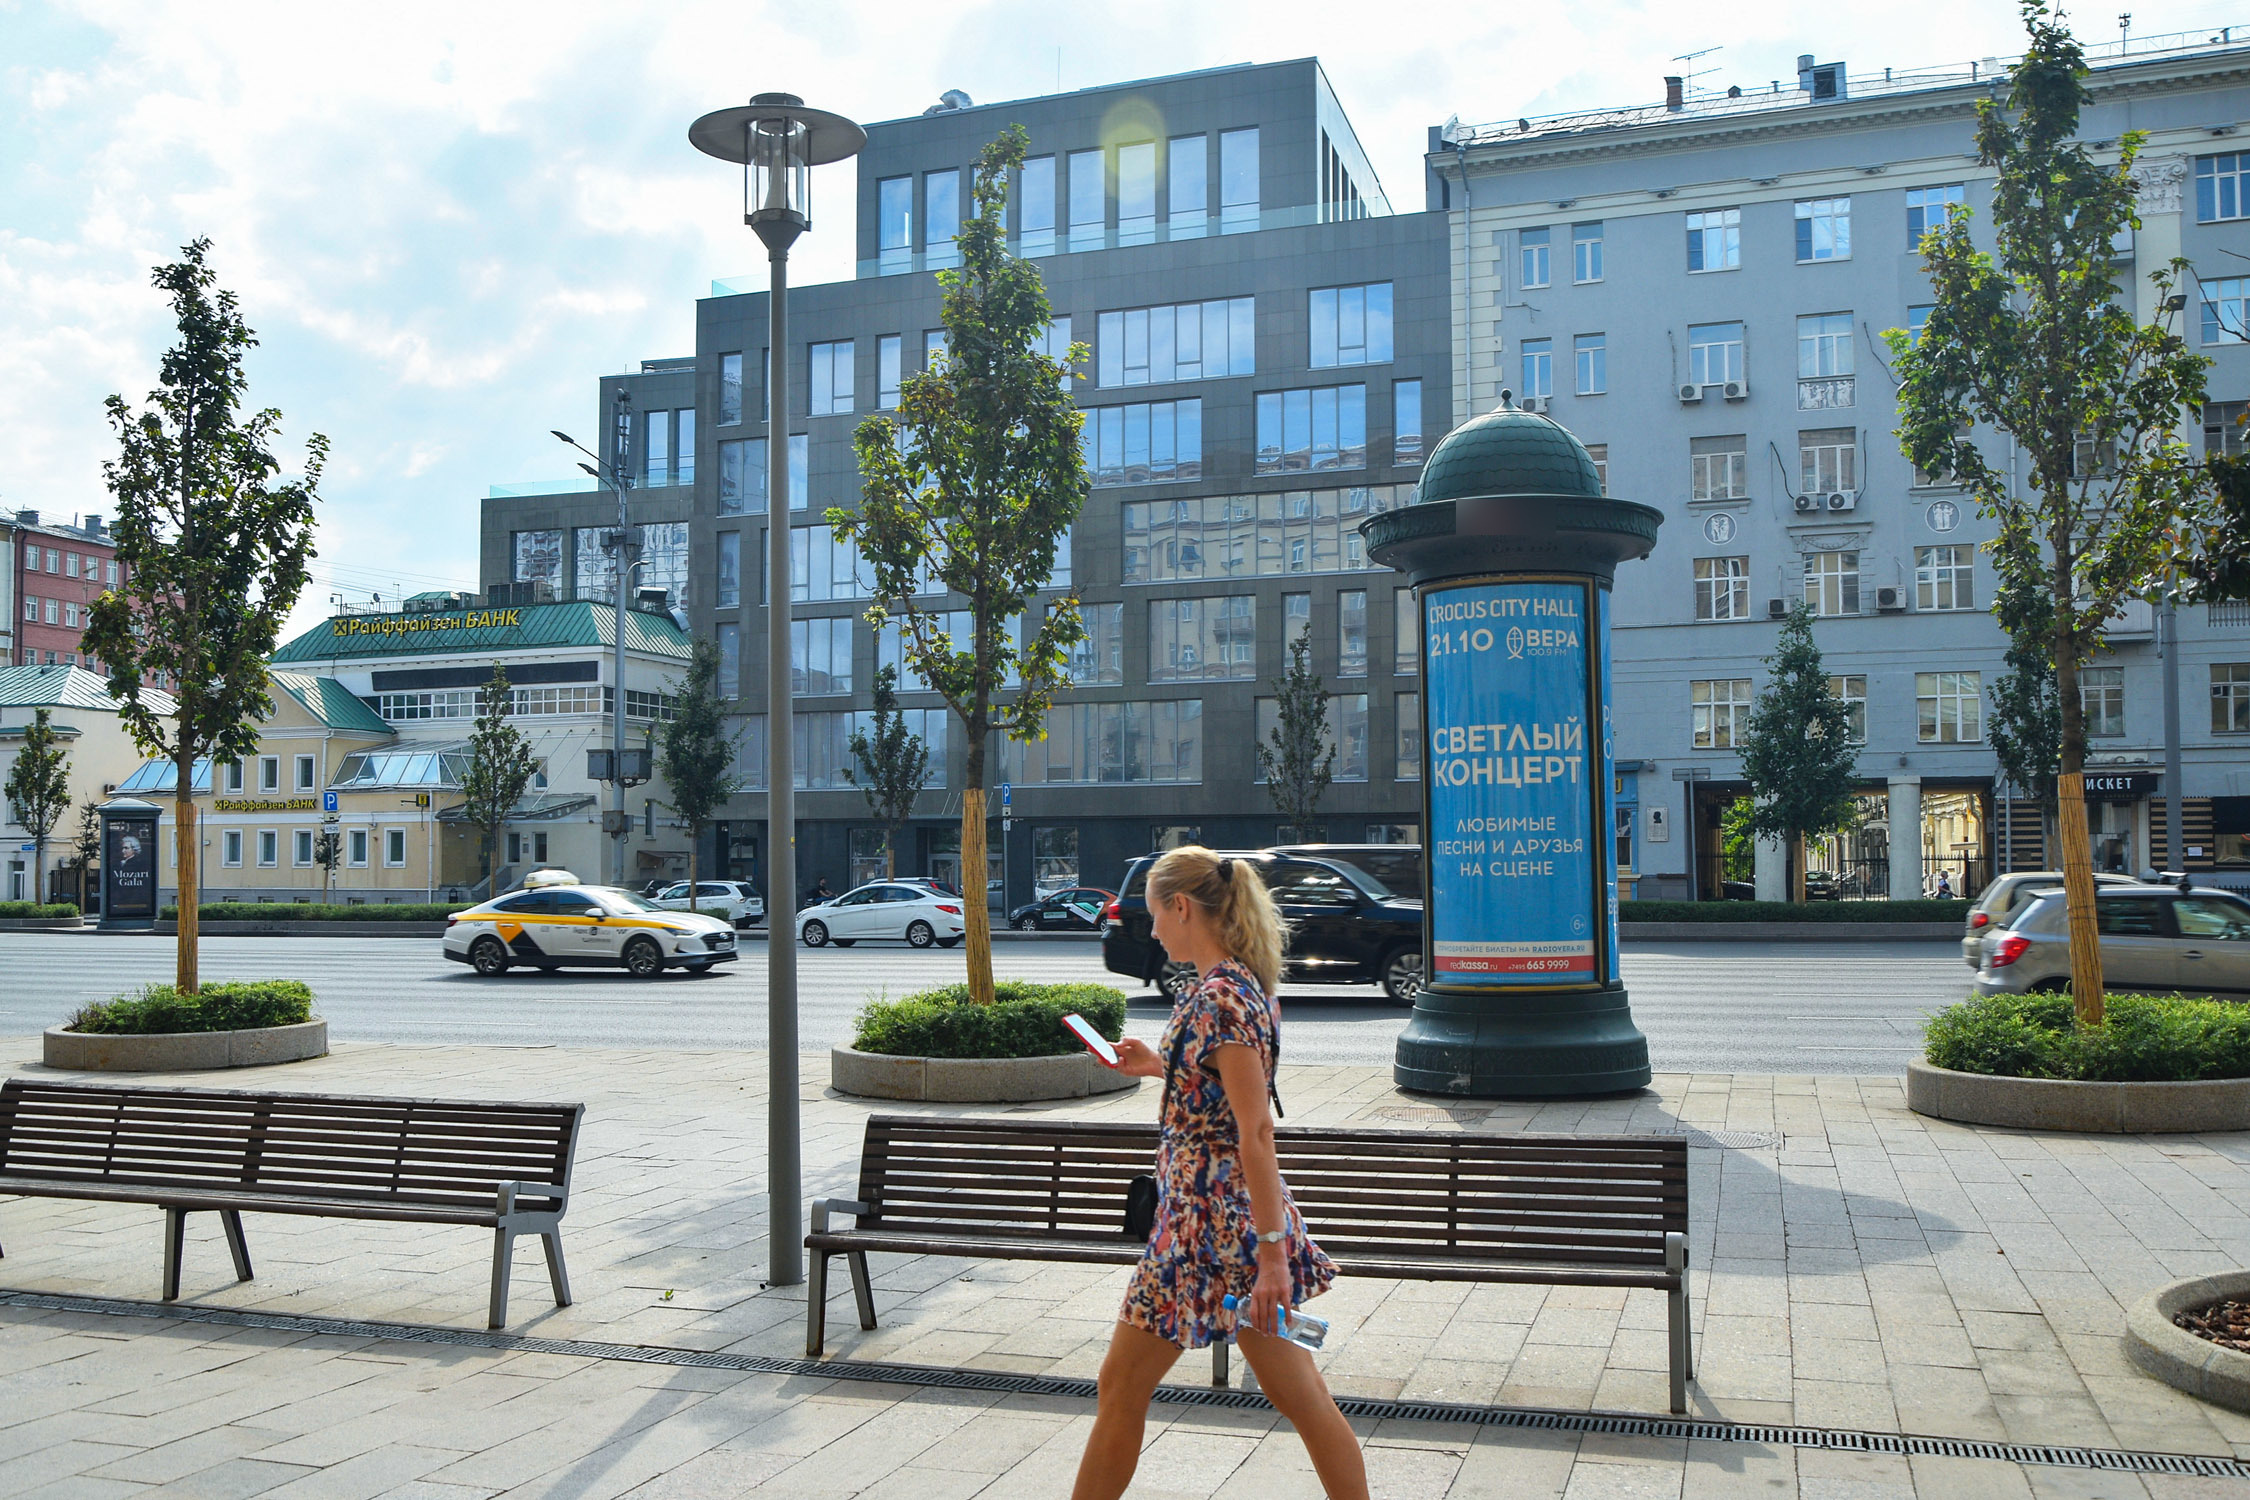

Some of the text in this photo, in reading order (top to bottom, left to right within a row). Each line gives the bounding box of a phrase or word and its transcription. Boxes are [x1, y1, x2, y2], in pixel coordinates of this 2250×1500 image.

[1430, 598, 1578, 624] CROCUS CITY HALL
[350, 609, 520, 637] Райффайзен БАНК
[1430, 628, 1494, 657] 21.10
[1527, 629, 1579, 648] ВЕРА
[1527, 647, 1567, 656] 100.9 FM
[1433, 716, 1582, 754] СВЕТЛЫЙ
[1434, 756, 1582, 789] КОНЦЕРТ
[2085, 777, 2133, 790] ИСКЕТ
[223, 799, 316, 811] Райффайзен БАНК
[1456, 816, 1556, 833] ЛЮБИМЫЕ
[1437, 838, 1583, 856] ПЕСНИ И ДРУЗЬЯ
[113, 870, 149, 878] Mozart
[1460, 861, 1554, 878] НА СЦЕНЕ
[119, 878, 143, 886] Gala
[1573, 919, 1585, 930] 6+
[1485, 945, 1517, 953] БИЛЕТЫ
[1519, 945, 1530, 953] НА
[1532, 944, 1585, 953] RADIOVERA.RU
[1526, 961, 1545, 970] 665
[1547, 960, 1570, 970] 9999
